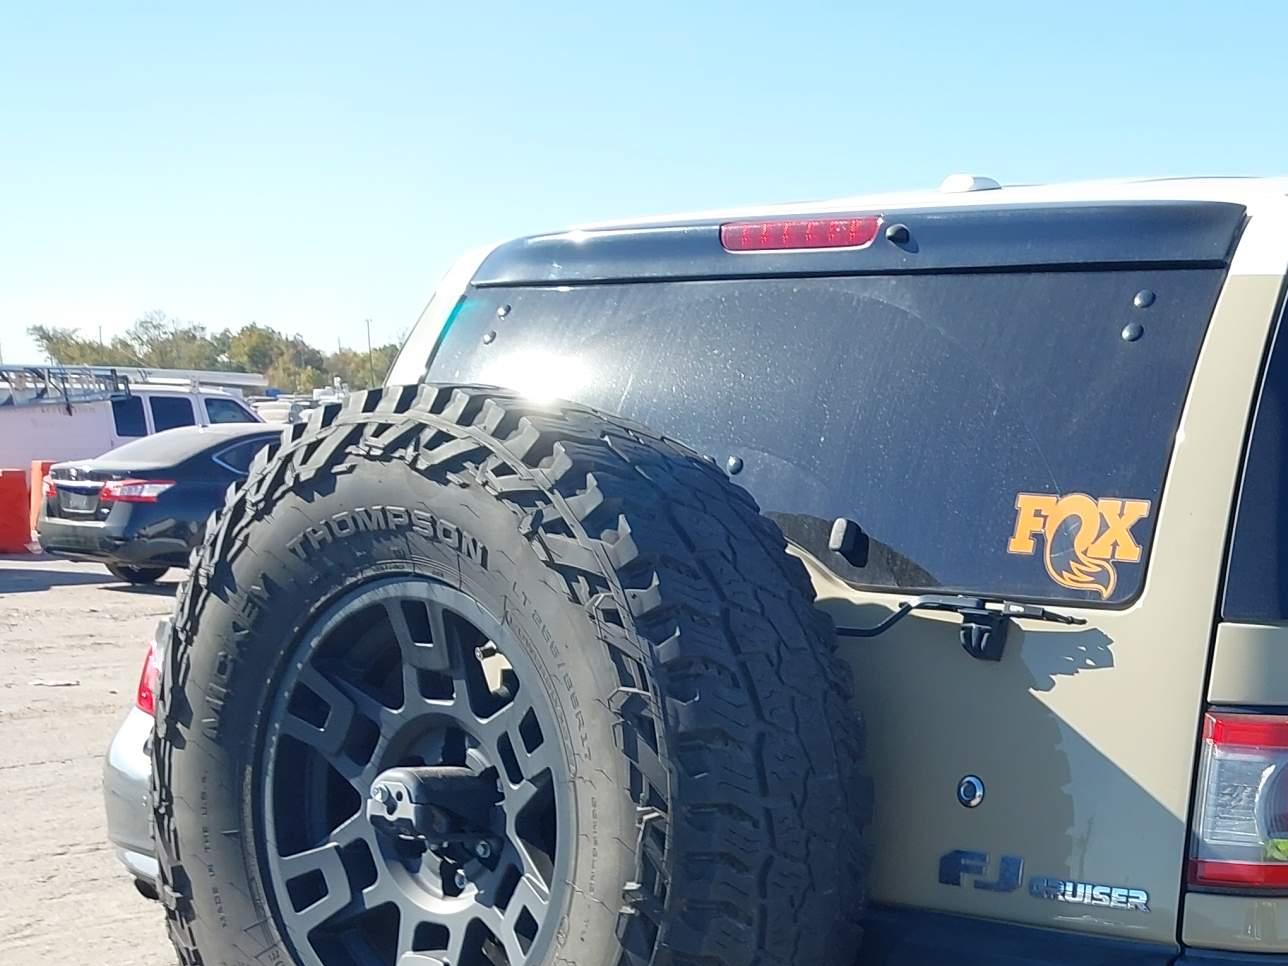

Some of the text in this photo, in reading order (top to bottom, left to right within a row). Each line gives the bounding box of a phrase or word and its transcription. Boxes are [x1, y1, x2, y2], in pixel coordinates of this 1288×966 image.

[1007, 492, 1151, 600] FOX
[200, 505, 489, 746] MICKEY THOMPSON
[938, 849, 1151, 913] FJ CRUISER
